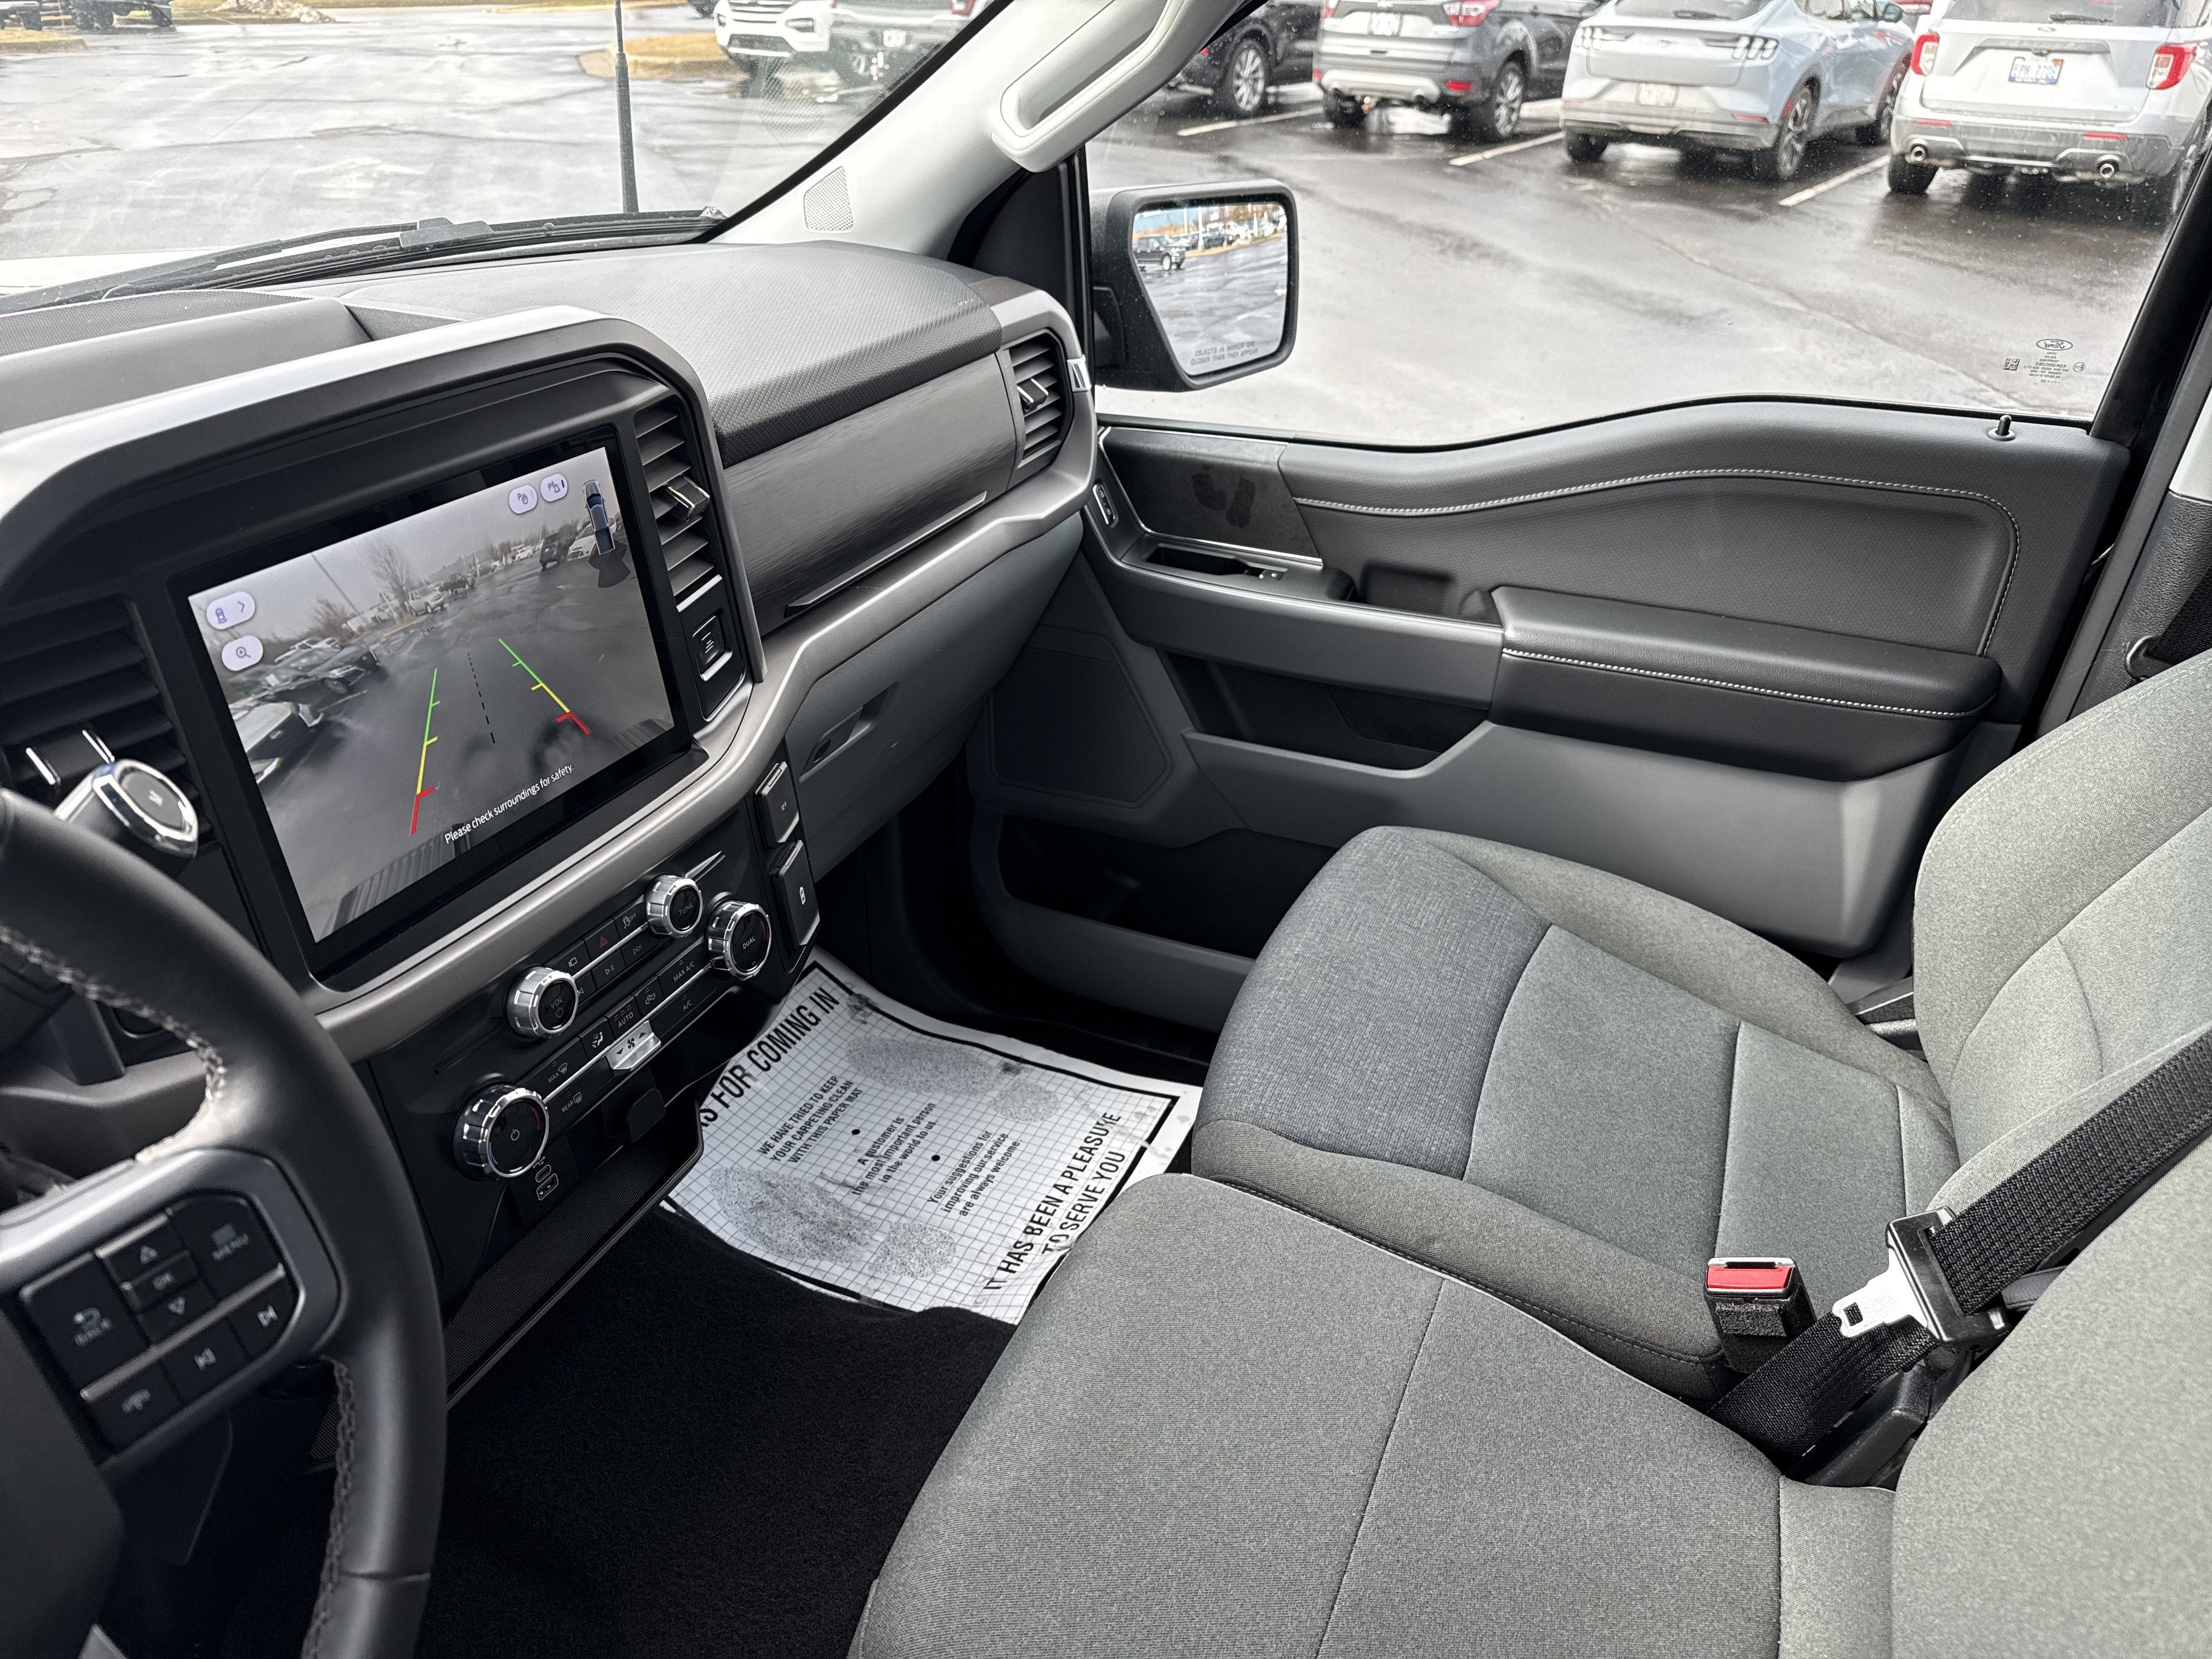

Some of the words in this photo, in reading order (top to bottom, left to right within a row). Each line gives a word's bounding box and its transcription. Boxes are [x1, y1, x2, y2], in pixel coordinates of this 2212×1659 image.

[444, 823, 472, 844] Please
[472, 810, 494, 828] check
[494, 783, 540, 816] surroundings
[540, 777, 551, 788] for
[551, 764, 574, 782] safety.
[628, 912, 637, 923] OFF
[678, 901, 693, 915] TUNE
[742, 936, 756, 950] DUAL
[673, 969, 686, 982] MAX
[686, 961, 695, 972] A/C
[550, 997, 563, 1009] VOL
[618, 1012, 634, 1028] AUTO
[682, 1000, 692, 1011] A/C
[710, 1065, 758, 1109] FOR
[747, 1005, 821, 1071] COMING
[809, 987, 840, 1014] IN
[548, 1072, 560, 1084] MAX
[561, 1101, 574, 1113] REAR
[757, 1141, 775, 1155] WE
[770, 1122, 794, 1143] HAVE
[788, 1102, 814, 1124] TRIED
[809, 1092, 823, 1103] TO
[819, 1076, 838, 1093] KEEP
[770, 1141, 796, 1161] YOUR
[792, 1102, 833, 1141] CARPETING
[829, 1080, 854, 1102] CLEAN
[788, 1143, 812, 1163] WITH
[806, 1125, 828, 1142] THIS
[824, 1103, 850, 1125] PAPER
[845, 1087, 864, 1103] MAT
[851, 1181, 868, 1195] the
[865, 1159, 886, 1180] most
[881, 1125, 917, 1159] important
[912, 1103, 936, 1125] person
[865, 1124, 897, 1158] customer
[878, 1175, 892, 1183] in
[887, 1161, 902, 1172] the
[899, 1139, 921, 1159] world
[916, 1131, 928, 1139] to
[924, 1120, 938, 1130] us.
[1060, 1112, 1122, 1181] PLEASURE
[927, 1186, 949, 1203] Your
[945, 1142, 984, 1185] suggestions
[978, 1131, 992, 1141] for
[940, 1173, 979, 1213] improving
[974, 1159, 988, 1172] our
[984, 1133, 1008, 1160] service
[959, 1201, 974, 1216] are
[970, 1174, 995, 1200] always
[991, 1139, 1023, 1173] welcome.
[1042, 1234, 1070, 1254] TO
[1059, 1185, 1105, 1231] SERVE
[1092, 1152, 1125, 1180] YOU
[1052, 1183, 1074, 1195] A
[1023, 1195, 1064, 1236] BEEN
[997, 1240, 1034, 1273] HAS
[983, 1277, 1007, 1289] IT
